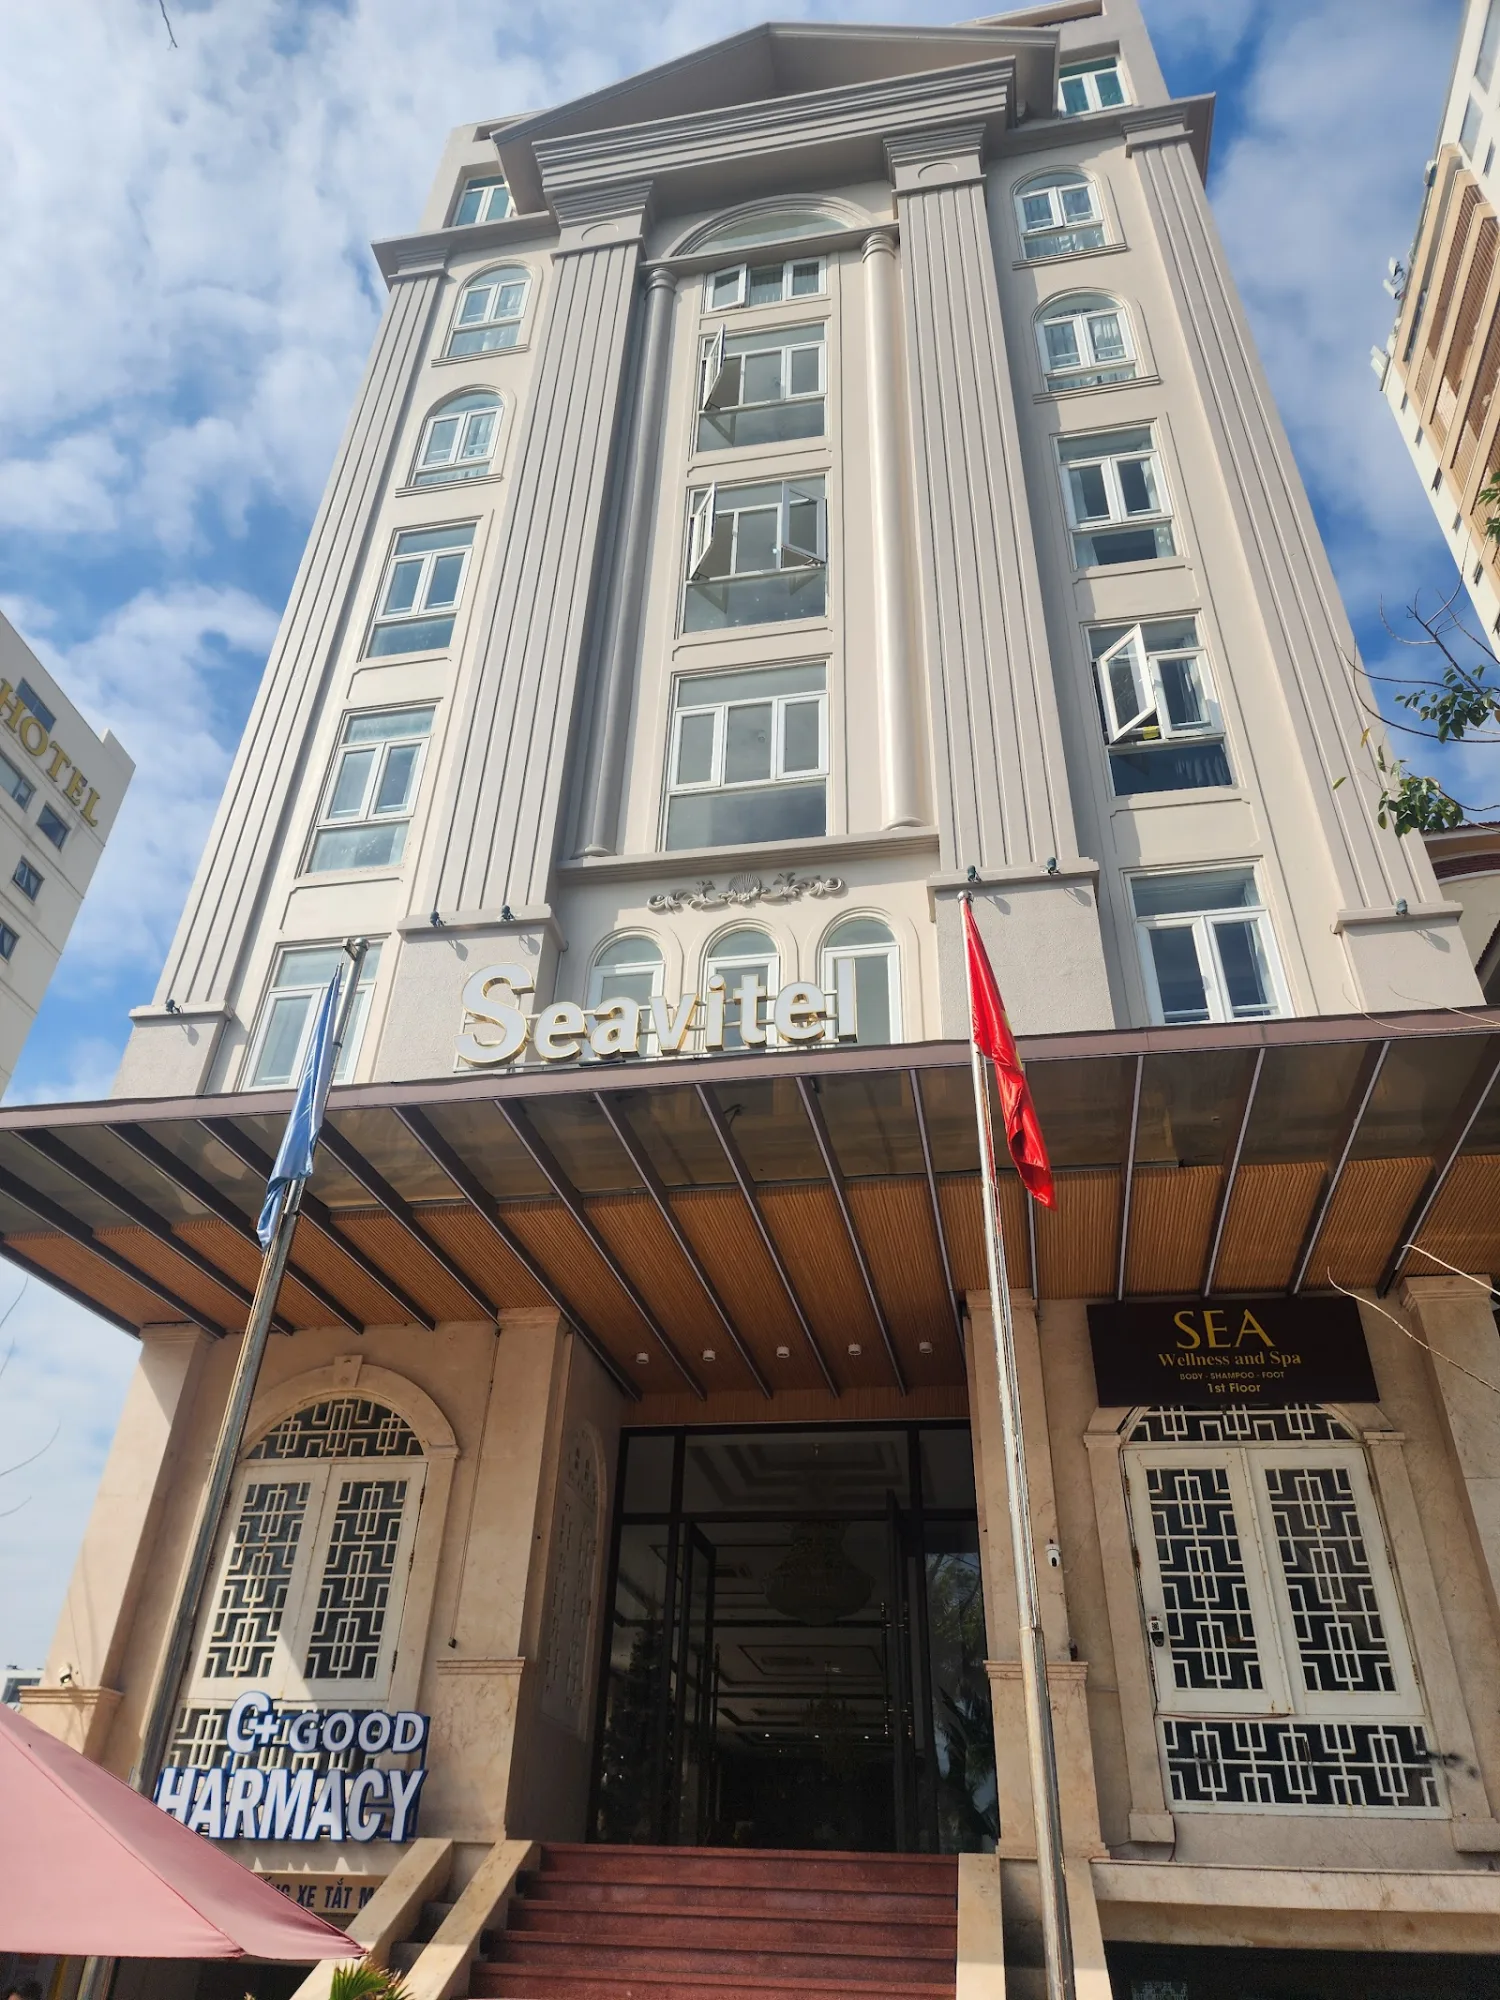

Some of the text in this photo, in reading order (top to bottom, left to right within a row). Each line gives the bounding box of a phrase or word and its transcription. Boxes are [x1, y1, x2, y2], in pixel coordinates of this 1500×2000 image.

[0, 678, 100, 827] HOTEL
[454, 957, 858, 1067] Seavitel
[1173, 1309, 1276, 1350] SEA
[1158, 1350, 1302, 1368] Wellness and Spa
[1179, 1372, 1203, 1381] BODY
[1210, 1371, 1253, 1380] SHAMPOO
[1261, 1371, 1285, 1379] FOOT
[1207, 1382, 1261, 1393] 1st Floor
[288, 1711, 429, 1753] GOOD
[152, 1766, 428, 1842] HARMACY
[297, 1884, 317, 1908] XE
